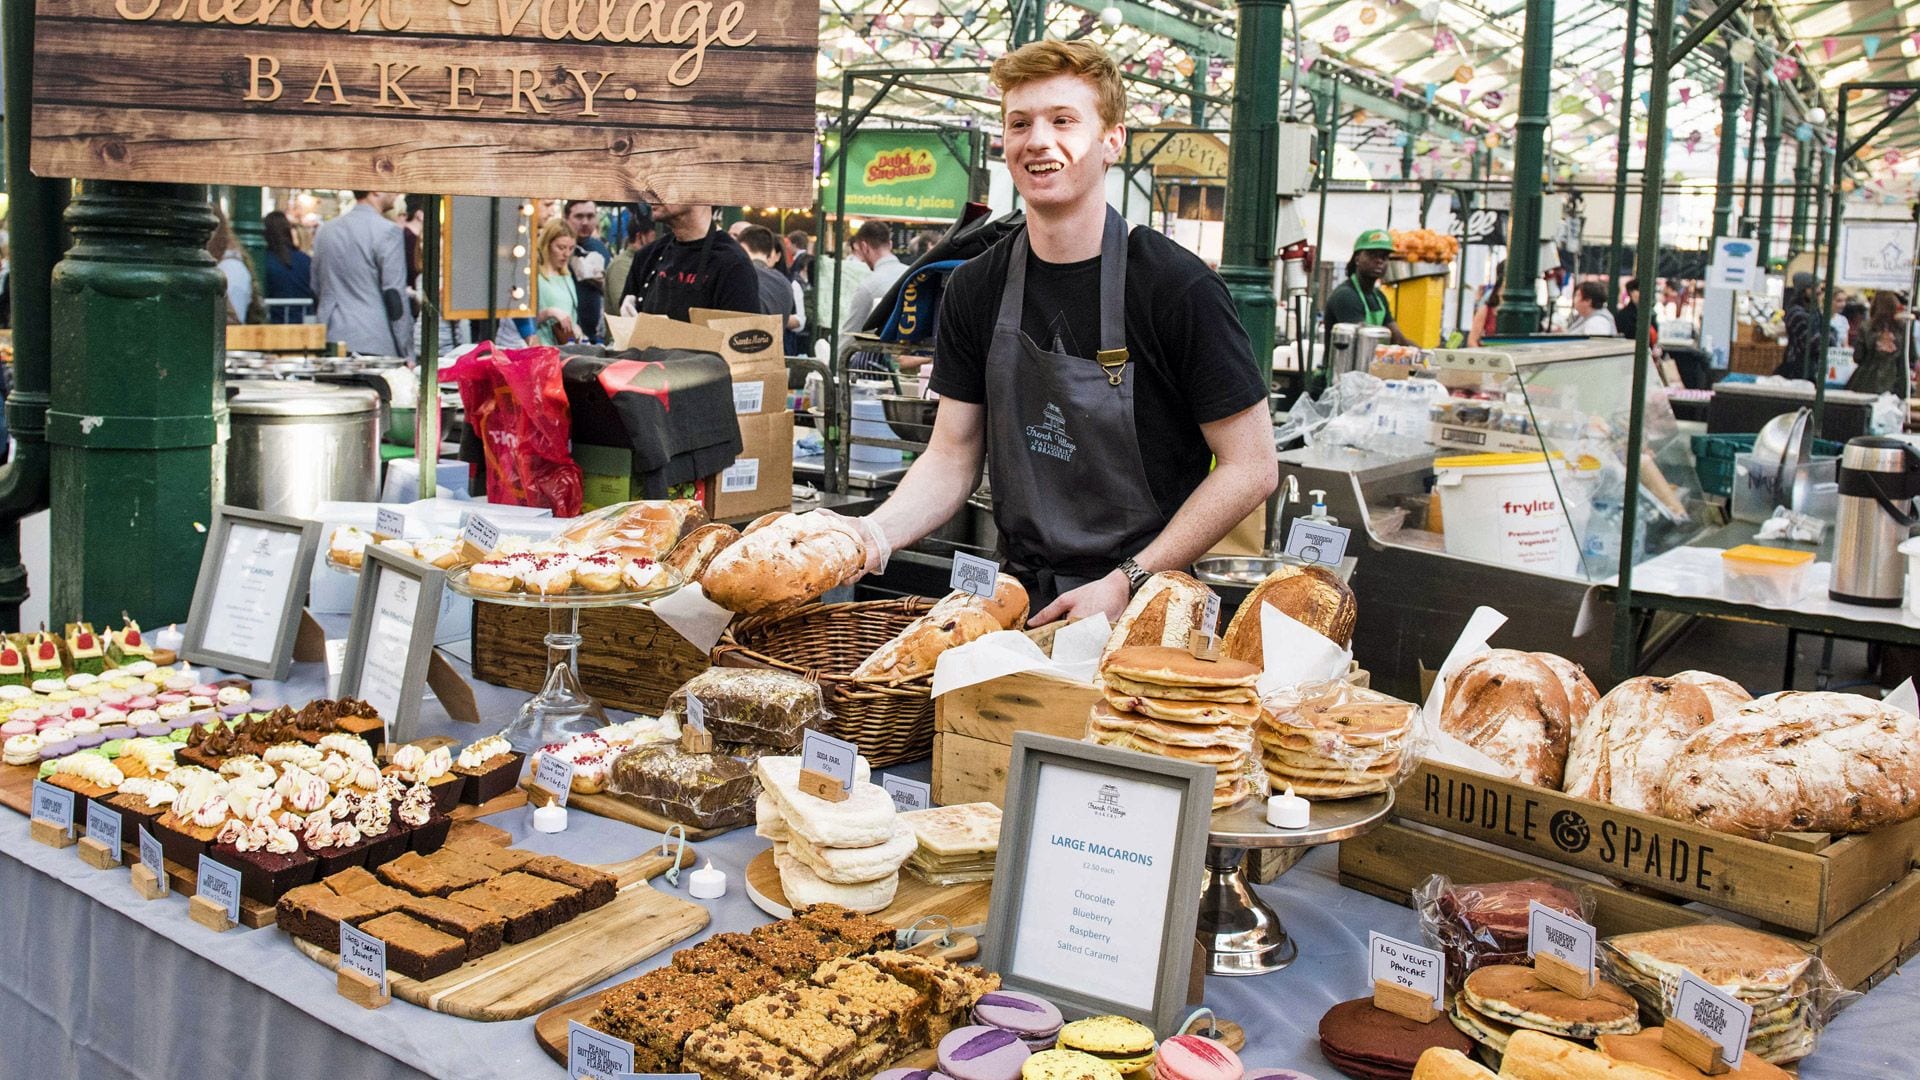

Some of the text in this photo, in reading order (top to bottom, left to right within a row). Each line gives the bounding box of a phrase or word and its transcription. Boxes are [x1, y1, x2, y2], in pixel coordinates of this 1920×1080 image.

[114, 0, 411, 32] ench
[1026, 425, 1077, 453] French Village
[1503, 500, 1555, 516] frylite
[1107, 806, 1127, 818] Village
[1425, 773, 1539, 842] RIDDLE
[1600, 820, 1714, 892] SPADE
[1051, 834, 1153, 866] LARGE MACARONS
[1101, 865, 1115, 875] each
[1074, 889, 1116, 907] Chocolate
[1072, 907, 1113, 925] Blueberry
[1069, 925, 1111, 944] Raspberry
[1546, 925, 1577, 946] BLUEBERRY
[1547, 933, 1575, 952] PANCAKE
[1057, 940, 1119, 963] Salted Caramel
[1380, 944, 1433, 968] RED VELVET
[1390, 960, 1426, 978] PANCAKE
[1699, 997, 1720, 1014] APPLE
[1693, 1002, 1728, 1029] CINNAMON
[1694, 1012, 1723, 1036] PANCAKE
[577, 1046, 597, 1061] BUTTER
[602, 1056, 623, 1072] HONEY
[588, 1043, 611, 1059] PEANUT
[586, 1058, 614, 1077] FLAPJACK
